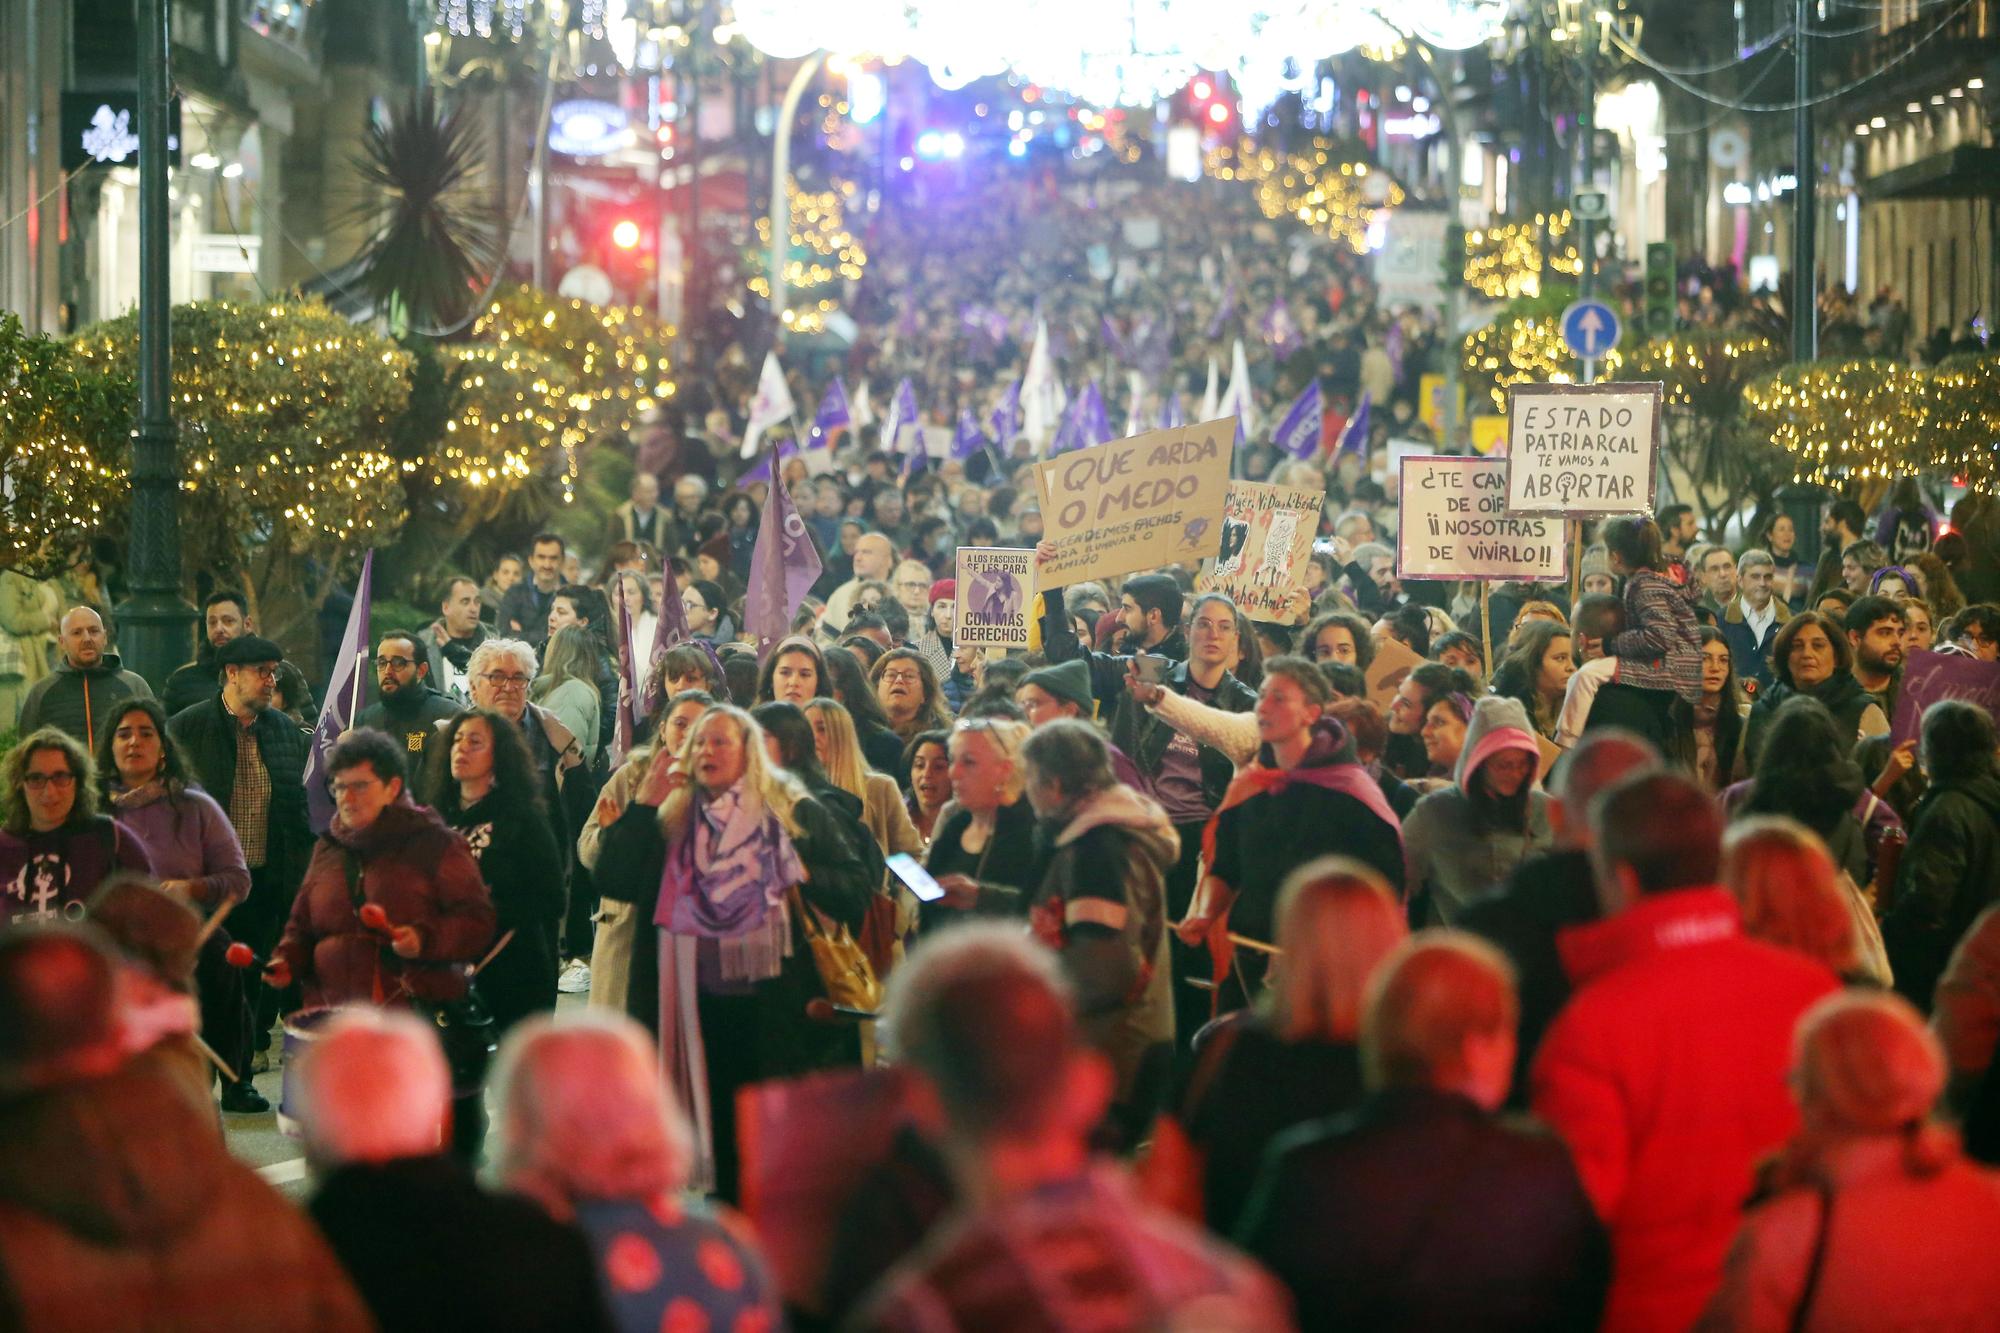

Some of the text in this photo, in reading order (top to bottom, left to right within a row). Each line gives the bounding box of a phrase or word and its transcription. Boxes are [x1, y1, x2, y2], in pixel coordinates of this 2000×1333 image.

[1524, 407, 1632, 429] ESTADO
[1525, 432, 1639, 454] PATRIARCAL
[1063, 435, 1218, 492] QUE ARDA
[1537, 454, 1609, 467] TE VAMOS A
[1058, 474, 1200, 529] O MEDO
[1446, 497, 1471, 513] DE
[967, 554, 1028, 564] A LOS FASCISTAS
[1428, 545, 1453, 560] DE
[982, 564, 999, 574] LES
[1002, 564, 1027, 574] PARA
[965, 609, 1024, 627] CON MÁS
[961, 627, 1027, 642] DERECHOS
